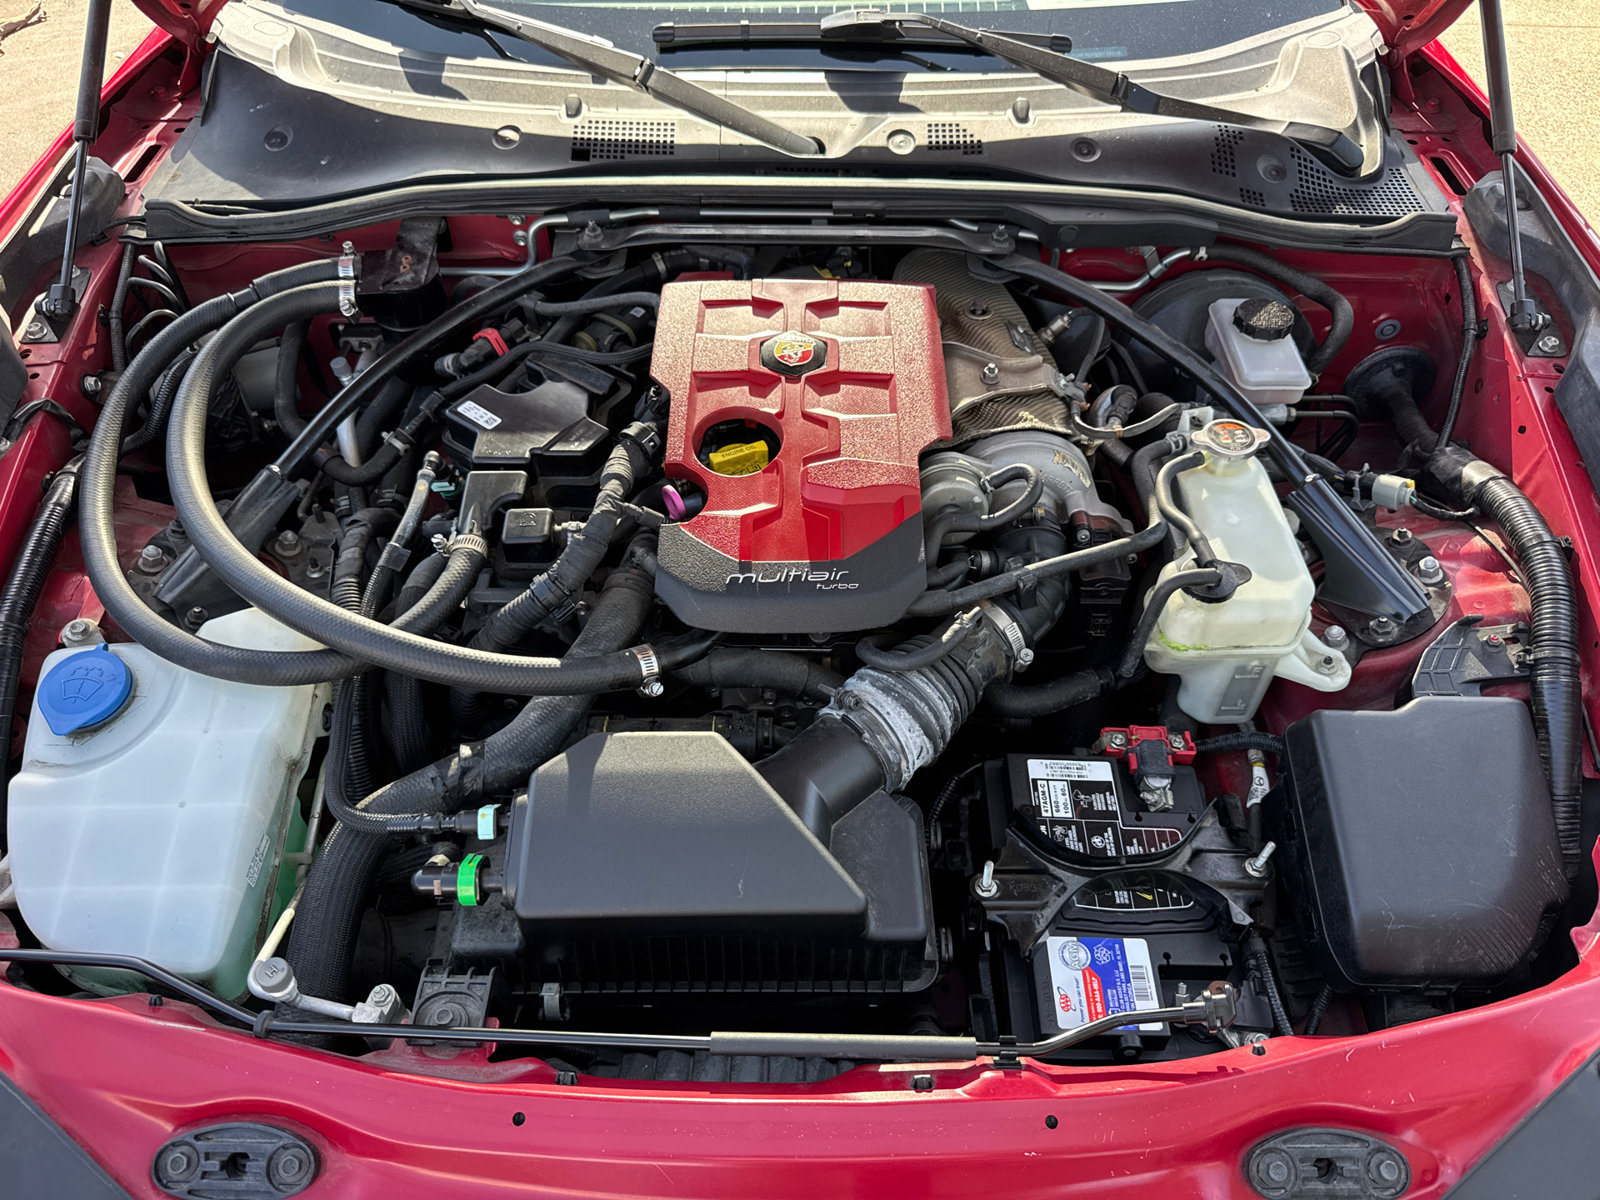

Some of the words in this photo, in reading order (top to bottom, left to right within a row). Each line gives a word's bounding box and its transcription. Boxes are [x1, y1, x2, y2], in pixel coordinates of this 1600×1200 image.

[721, 448, 745, 458] ENGINE
[725, 567, 849, 584] multiair
[1040, 784, 1048, 813] 47AGM-C
[1060, 788, 1066, 796] 60
[1067, 942, 1081, 969] AGM
[264, 964, 279, 979] H
[1060, 994, 1071, 1012] AAA
